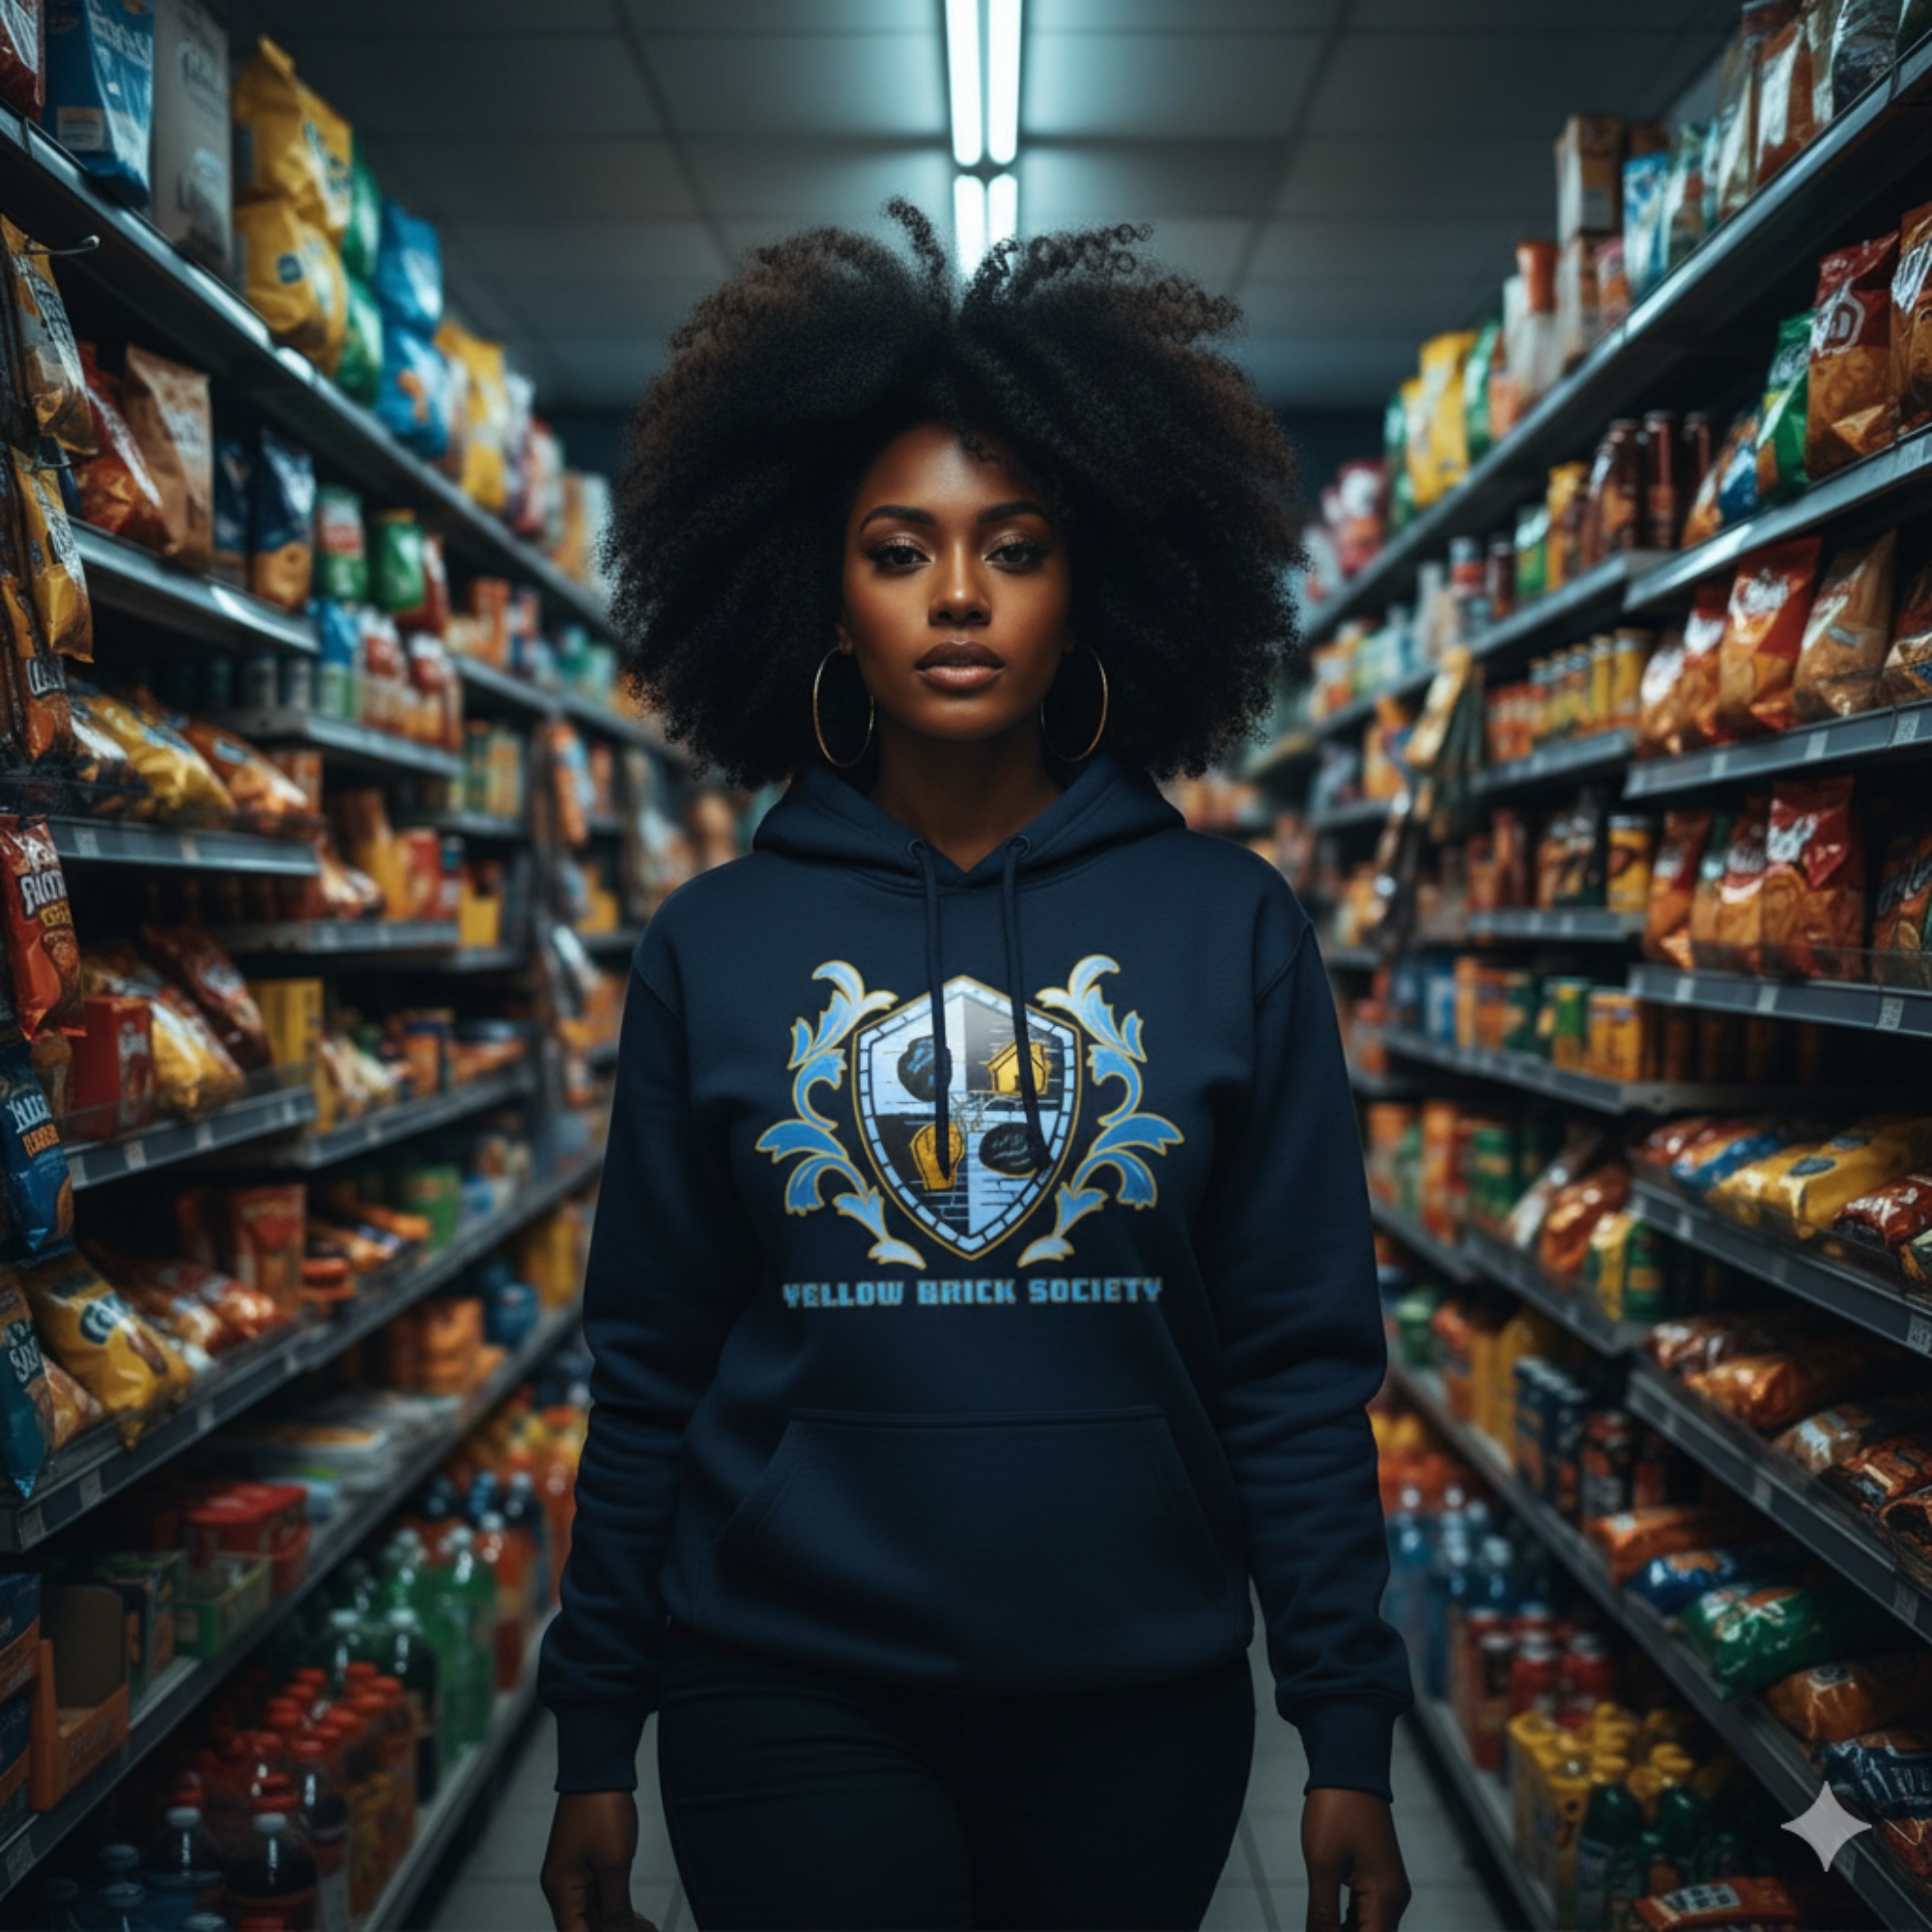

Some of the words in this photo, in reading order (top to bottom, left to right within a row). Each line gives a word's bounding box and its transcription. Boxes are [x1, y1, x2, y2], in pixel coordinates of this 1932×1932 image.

[782, 1281, 904, 1308] YELLOW
[917, 1279, 1017, 1305] BRICK
[1028, 1277, 1162, 1303] SOCIETY
